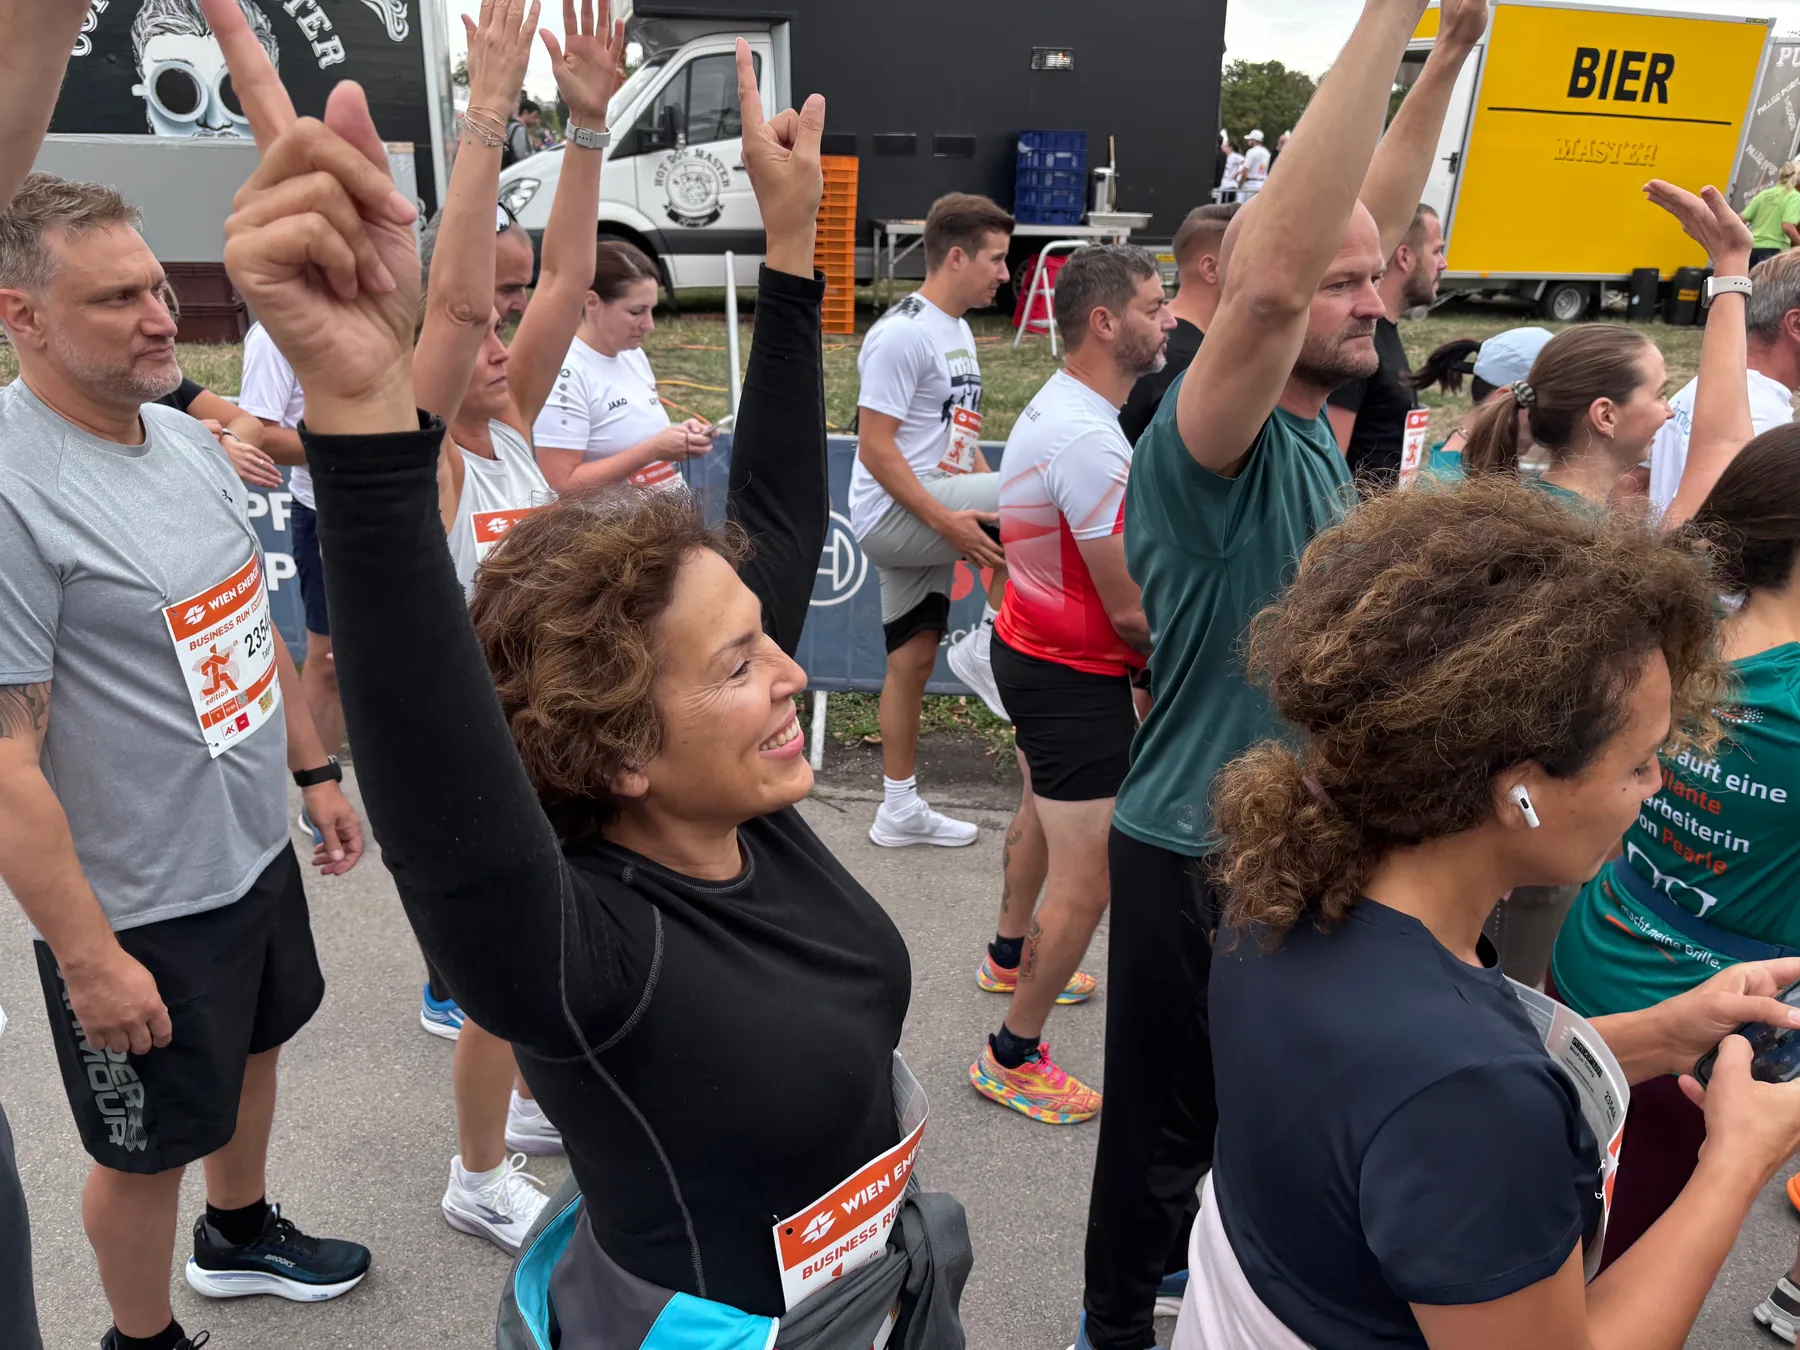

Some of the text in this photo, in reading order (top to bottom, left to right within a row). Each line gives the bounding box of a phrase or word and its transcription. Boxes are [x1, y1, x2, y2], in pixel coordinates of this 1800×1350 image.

[1567, 47, 1675, 104] BIER
[654, 163, 669, 187] HOT
[694, 148, 731, 187] MASTER
[1553, 138, 1658, 167] MASTER
[608, 398, 628, 411] JAKO
[208, 588, 237, 610] WIEN
[189, 620, 234, 651] BUSINESS
[236, 608, 250, 625] RUN
[205, 688, 229, 705] edition
[1660, 767, 1722, 815] llante
[1725, 774, 1787, 803] eine
[1636, 812, 1727, 875] on Pearle
[1620, 904, 1650, 932] macht
[1685, 943, 1721, 970] Brille.
[841, 1173, 890, 1215] WIEN
[264, 1253, 296, 1268] BROOKS
[802, 1223, 878, 1280] BUSINESS
